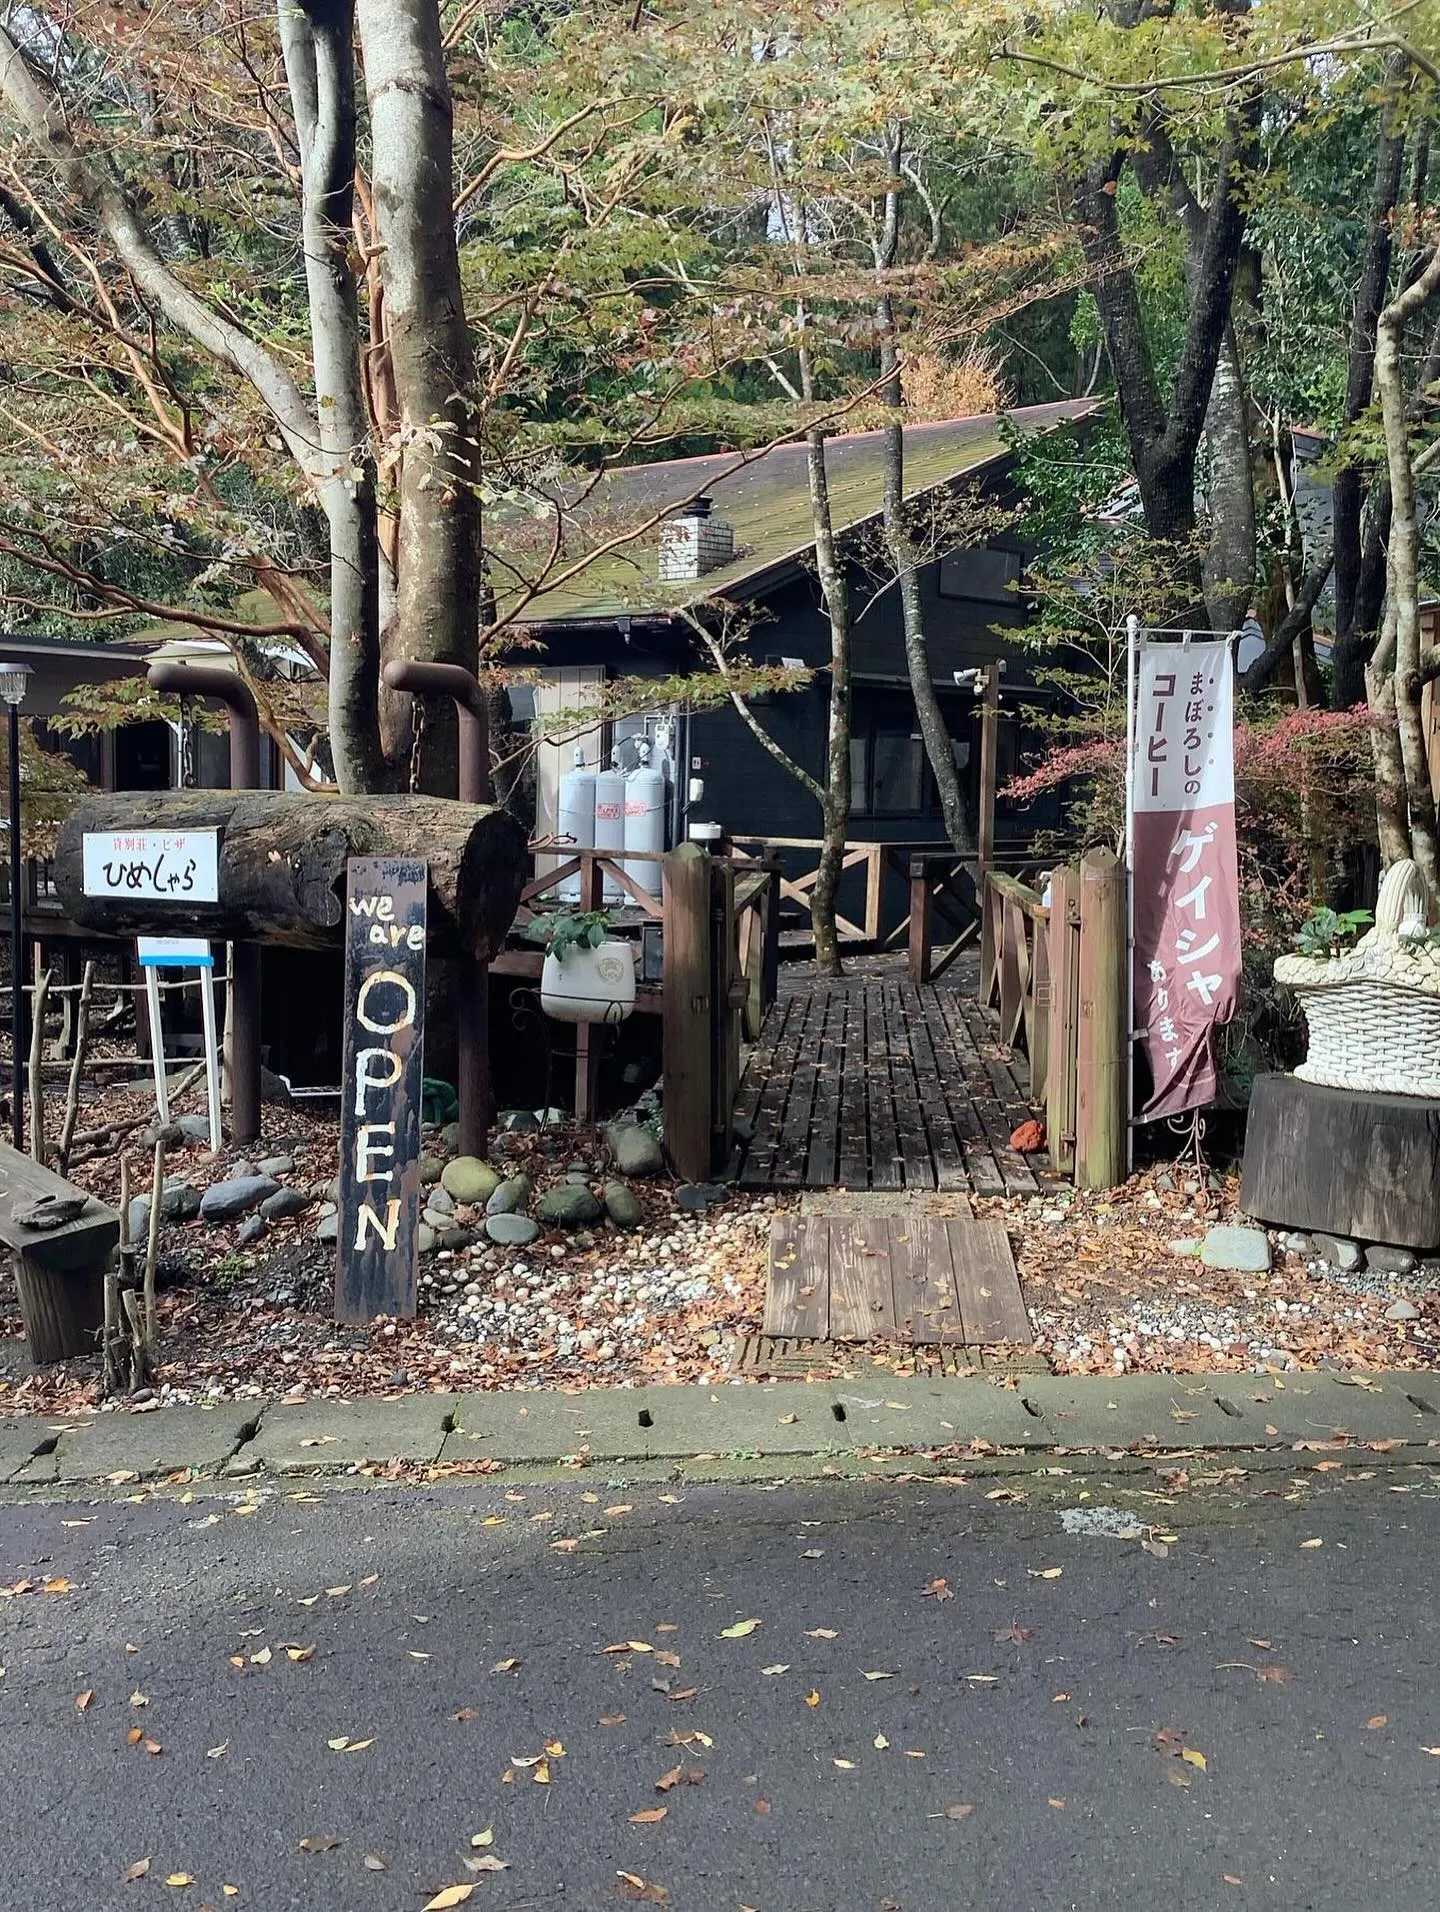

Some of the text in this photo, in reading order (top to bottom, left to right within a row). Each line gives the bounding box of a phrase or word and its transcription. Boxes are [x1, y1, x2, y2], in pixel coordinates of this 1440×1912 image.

[1147, 674, 1177, 797] コーヒー
[1183, 671, 1205, 796] まぼろしの
[102, 853, 197, 892] ひめしゃら
[349, 895, 395, 921] we
[1171, 821, 1224, 1006] ゲイシャ
[369, 924, 426, 951] are
[1146, 959, 1183, 1079] あります
[353, 970, 417, 1251] OPEN
